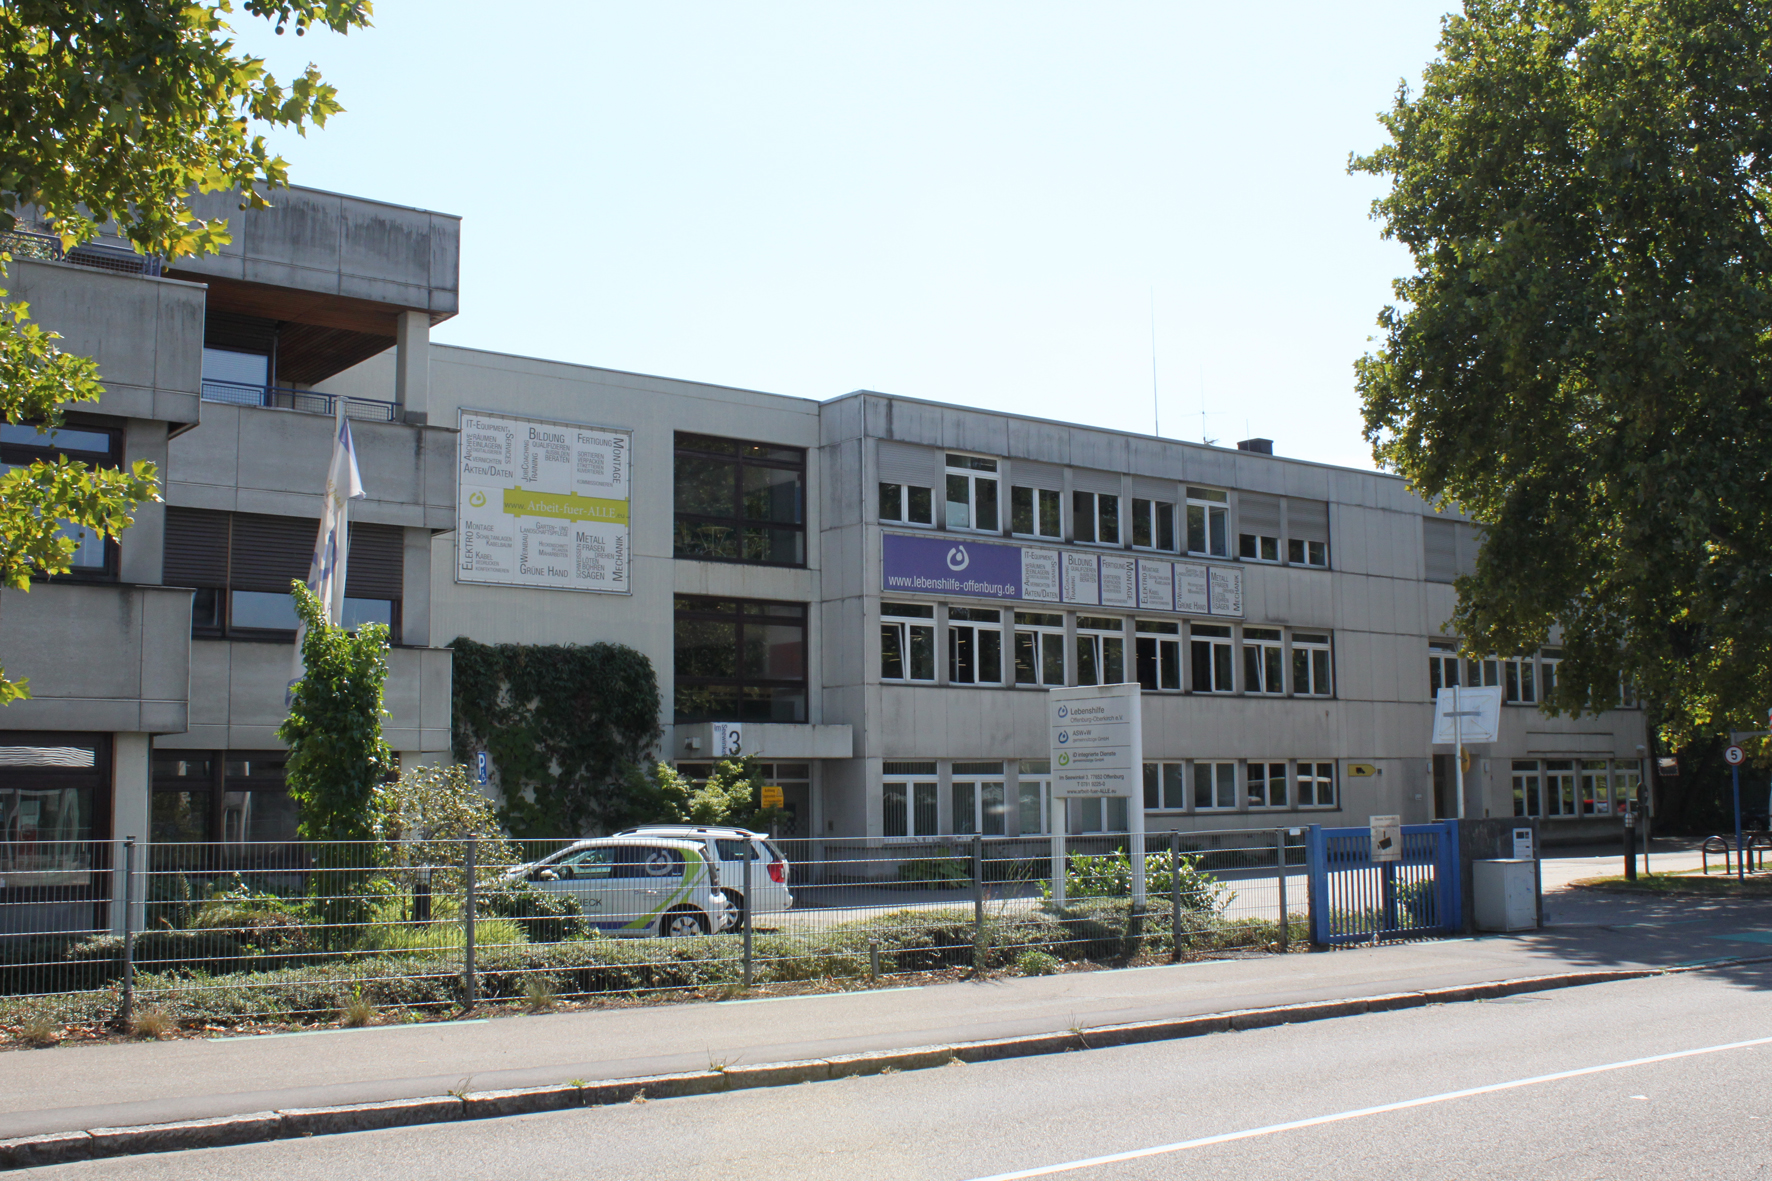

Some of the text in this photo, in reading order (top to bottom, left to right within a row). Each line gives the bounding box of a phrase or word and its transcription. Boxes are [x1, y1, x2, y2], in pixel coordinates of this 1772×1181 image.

[529, 427, 565, 443] BILDUNG
[577, 433, 612, 447] FERTIGUNG
[545, 455, 570, 463] BERATEN
[612, 437, 624, 484] MONTAGE
[463, 463, 514, 478] AKTEN/DATEN
[465, 520, 494, 531] MONTAGE
[576, 531, 606, 545] METALL
[462, 530, 474, 571] ELEKTRO
[475, 551, 493, 560] KABEL
[612, 535, 623, 582] MECHANIK
[1068, 554, 1093, 567] BILDUNG
[520, 563, 569, 577] GRÜNE HAND
[888, 576, 1015, 596] www.lebenshilfe-offenburg.de
[1126, 561, 1134, 600] MONTAGE
[1070, 706, 1104, 715] Lebenshilfe
[1070, 715, 1114, 723] Offenburg-Oberkirch
[729, 731, 741, 756] 3
[1730, 750, 1738, 760] 5
[479, 754, 486, 775] P
